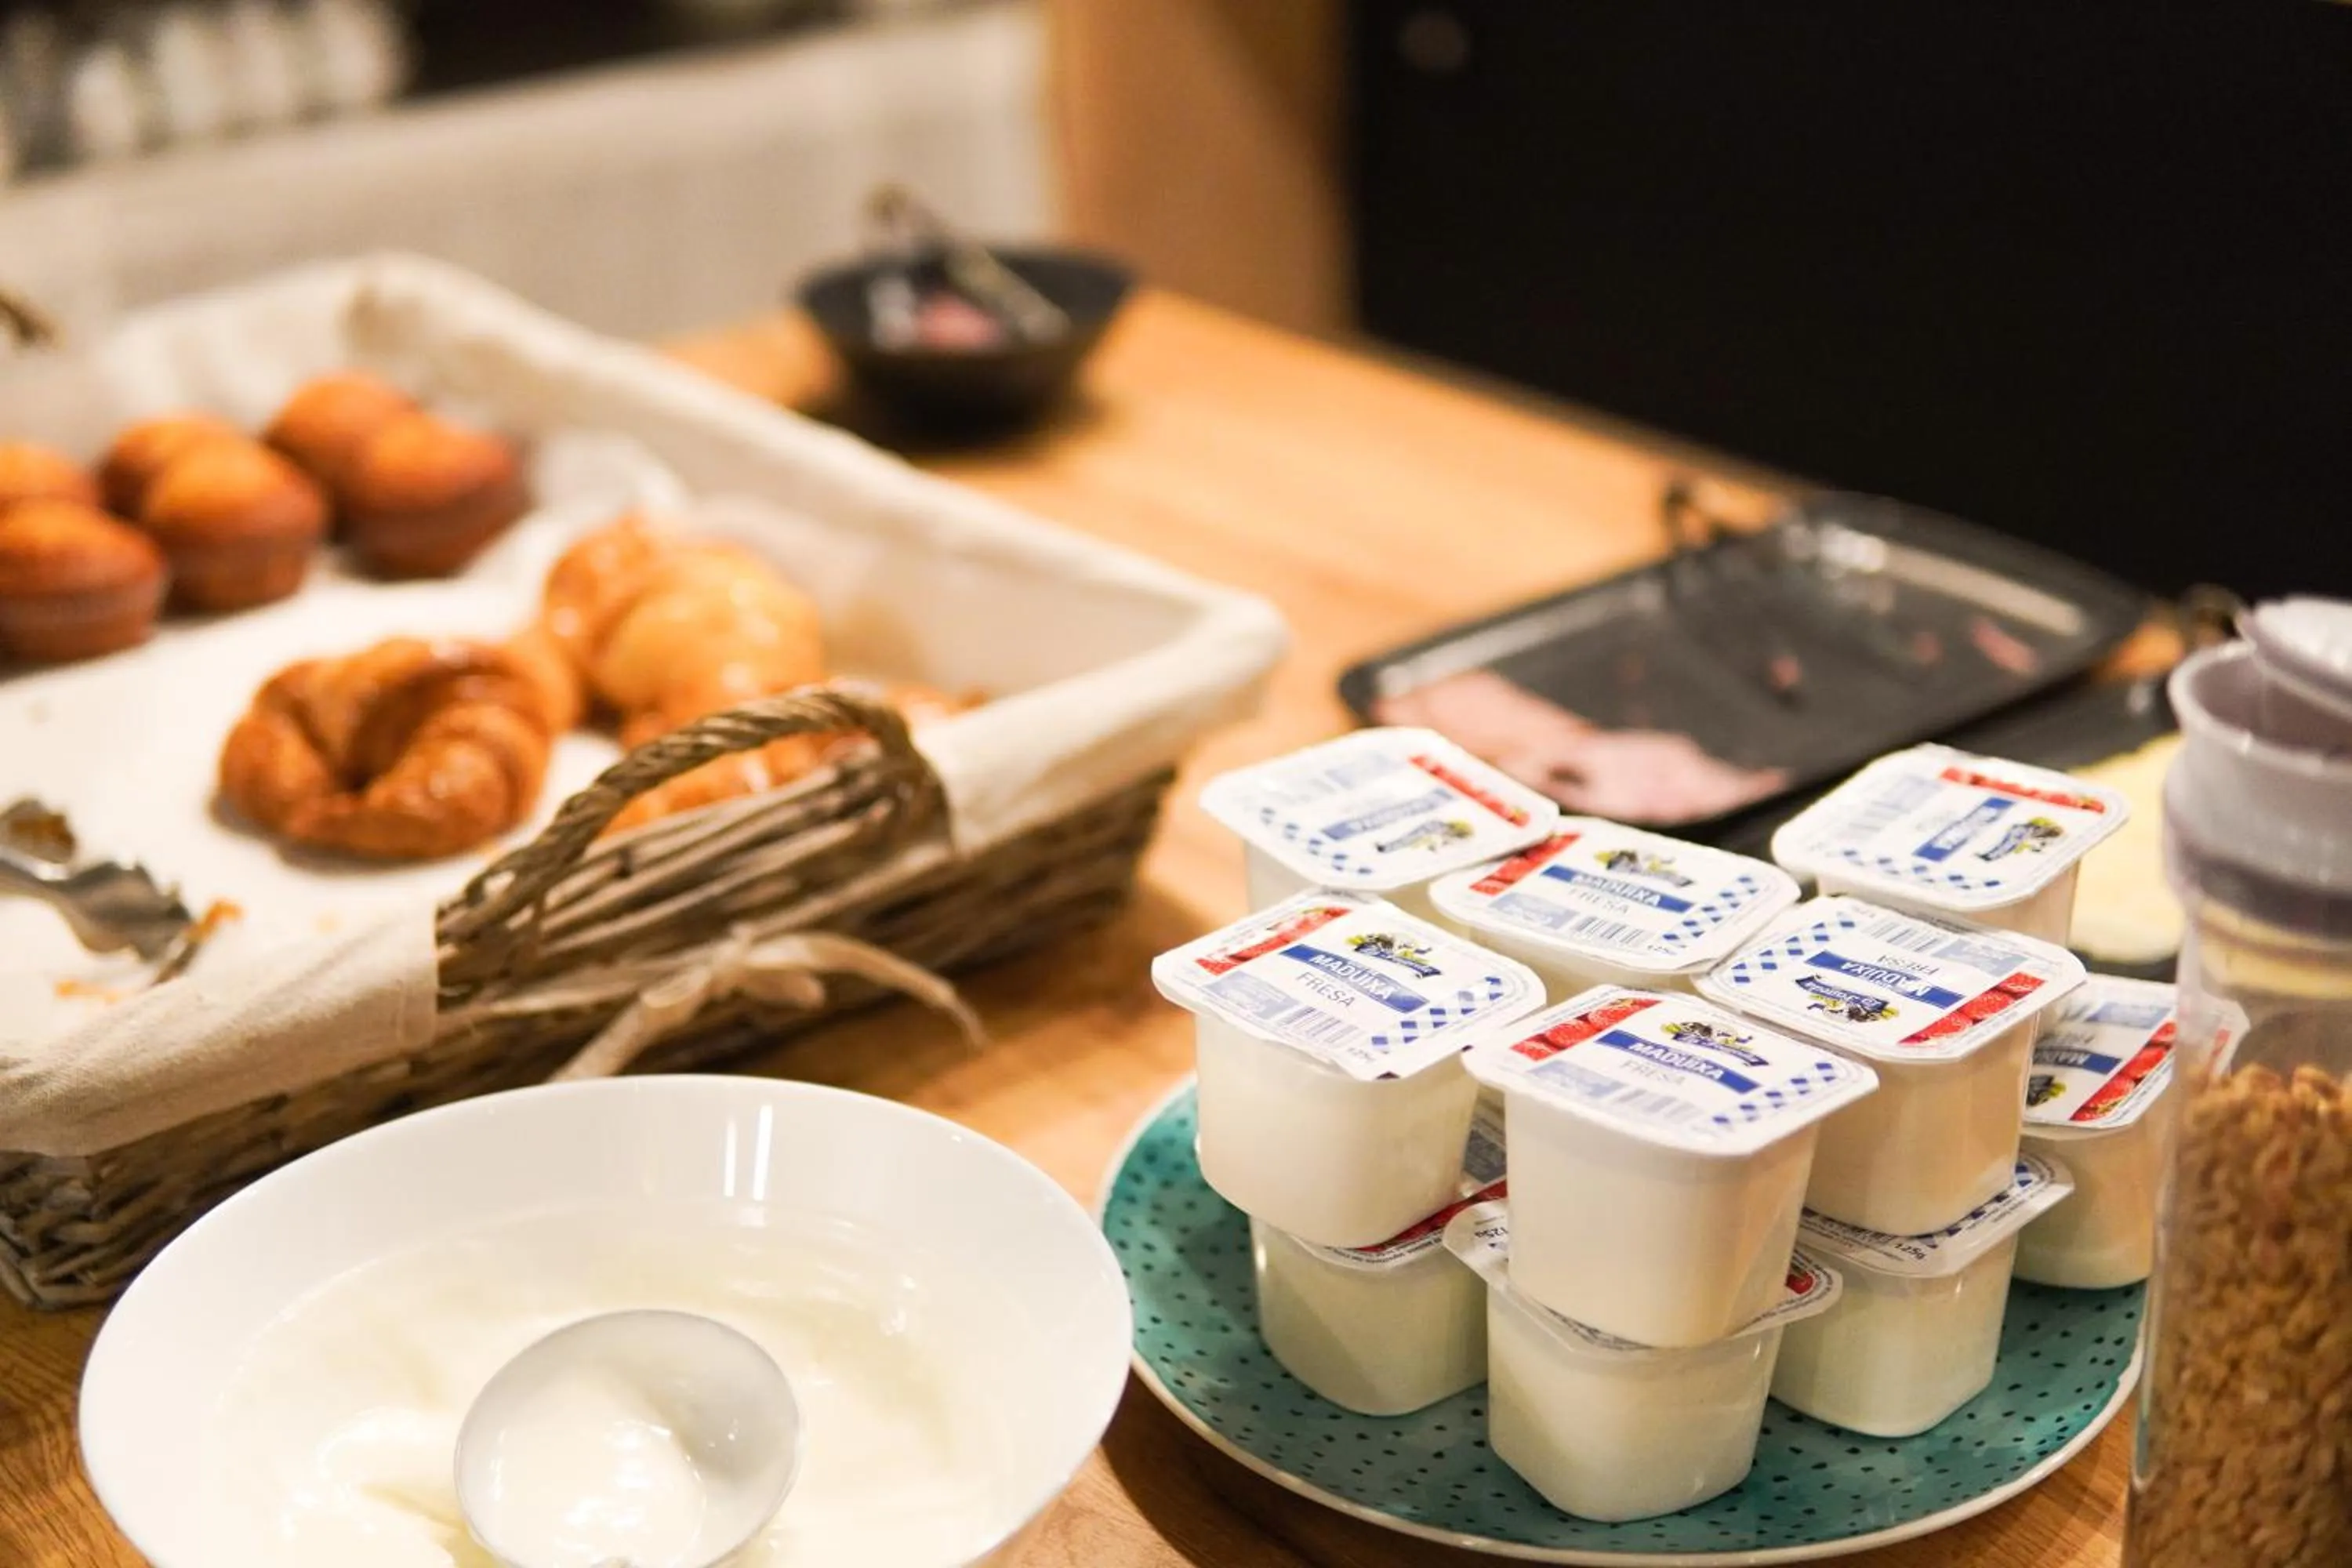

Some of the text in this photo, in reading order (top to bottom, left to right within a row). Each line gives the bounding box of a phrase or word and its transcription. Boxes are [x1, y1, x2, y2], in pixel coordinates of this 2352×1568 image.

[1296, 971, 1356, 1007] FRESA
[1309, 954, 1400, 1000] MADUIXA
[1842, 962, 1930, 996] MADUIXA
[1629, 1044, 1724, 1080] MADUIXA
